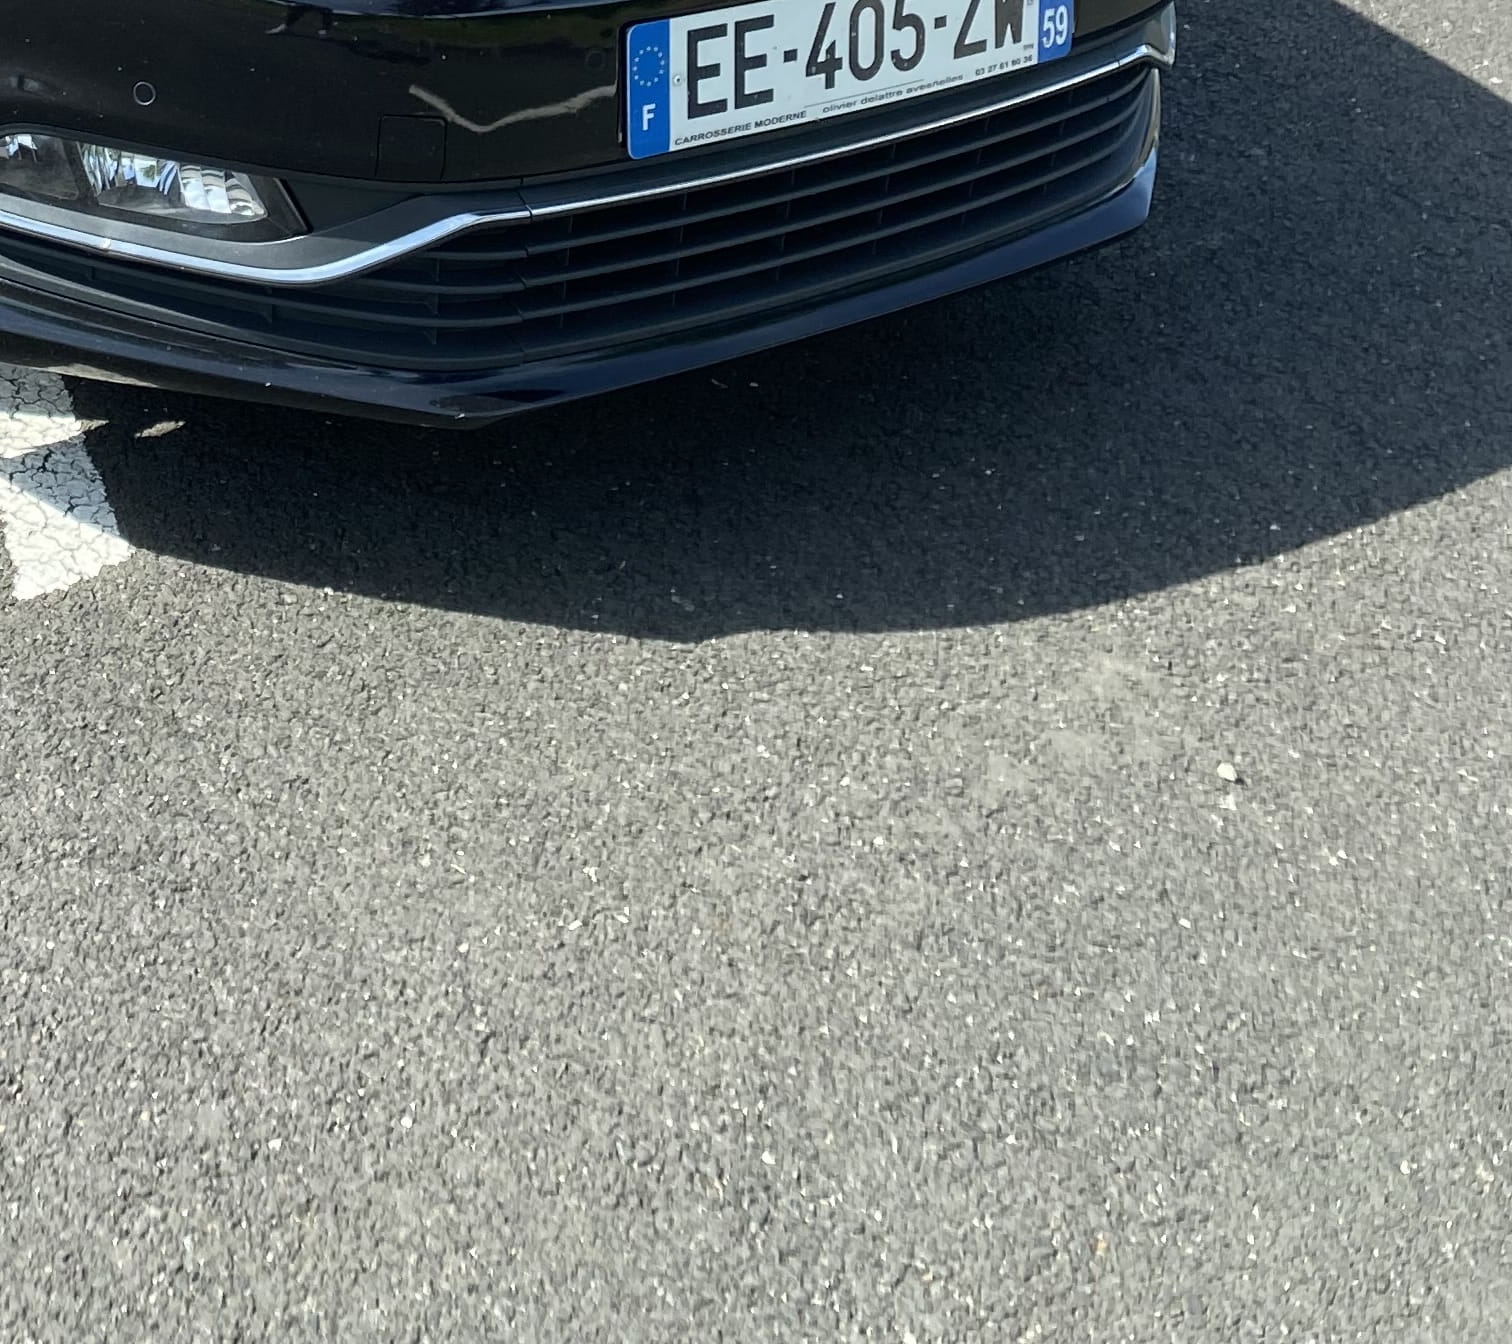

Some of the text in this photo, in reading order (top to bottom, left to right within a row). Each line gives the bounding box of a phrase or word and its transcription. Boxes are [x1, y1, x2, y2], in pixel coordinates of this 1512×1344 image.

[1042, 5, 1068, 48] 59
[642, 103, 656, 131] F
[675, 122, 752, 146] CARROSSERIE
[754, 111, 807, 129] MODERNE
[822, 99, 857, 113] olivier
[860, 89, 903, 105] delattre
